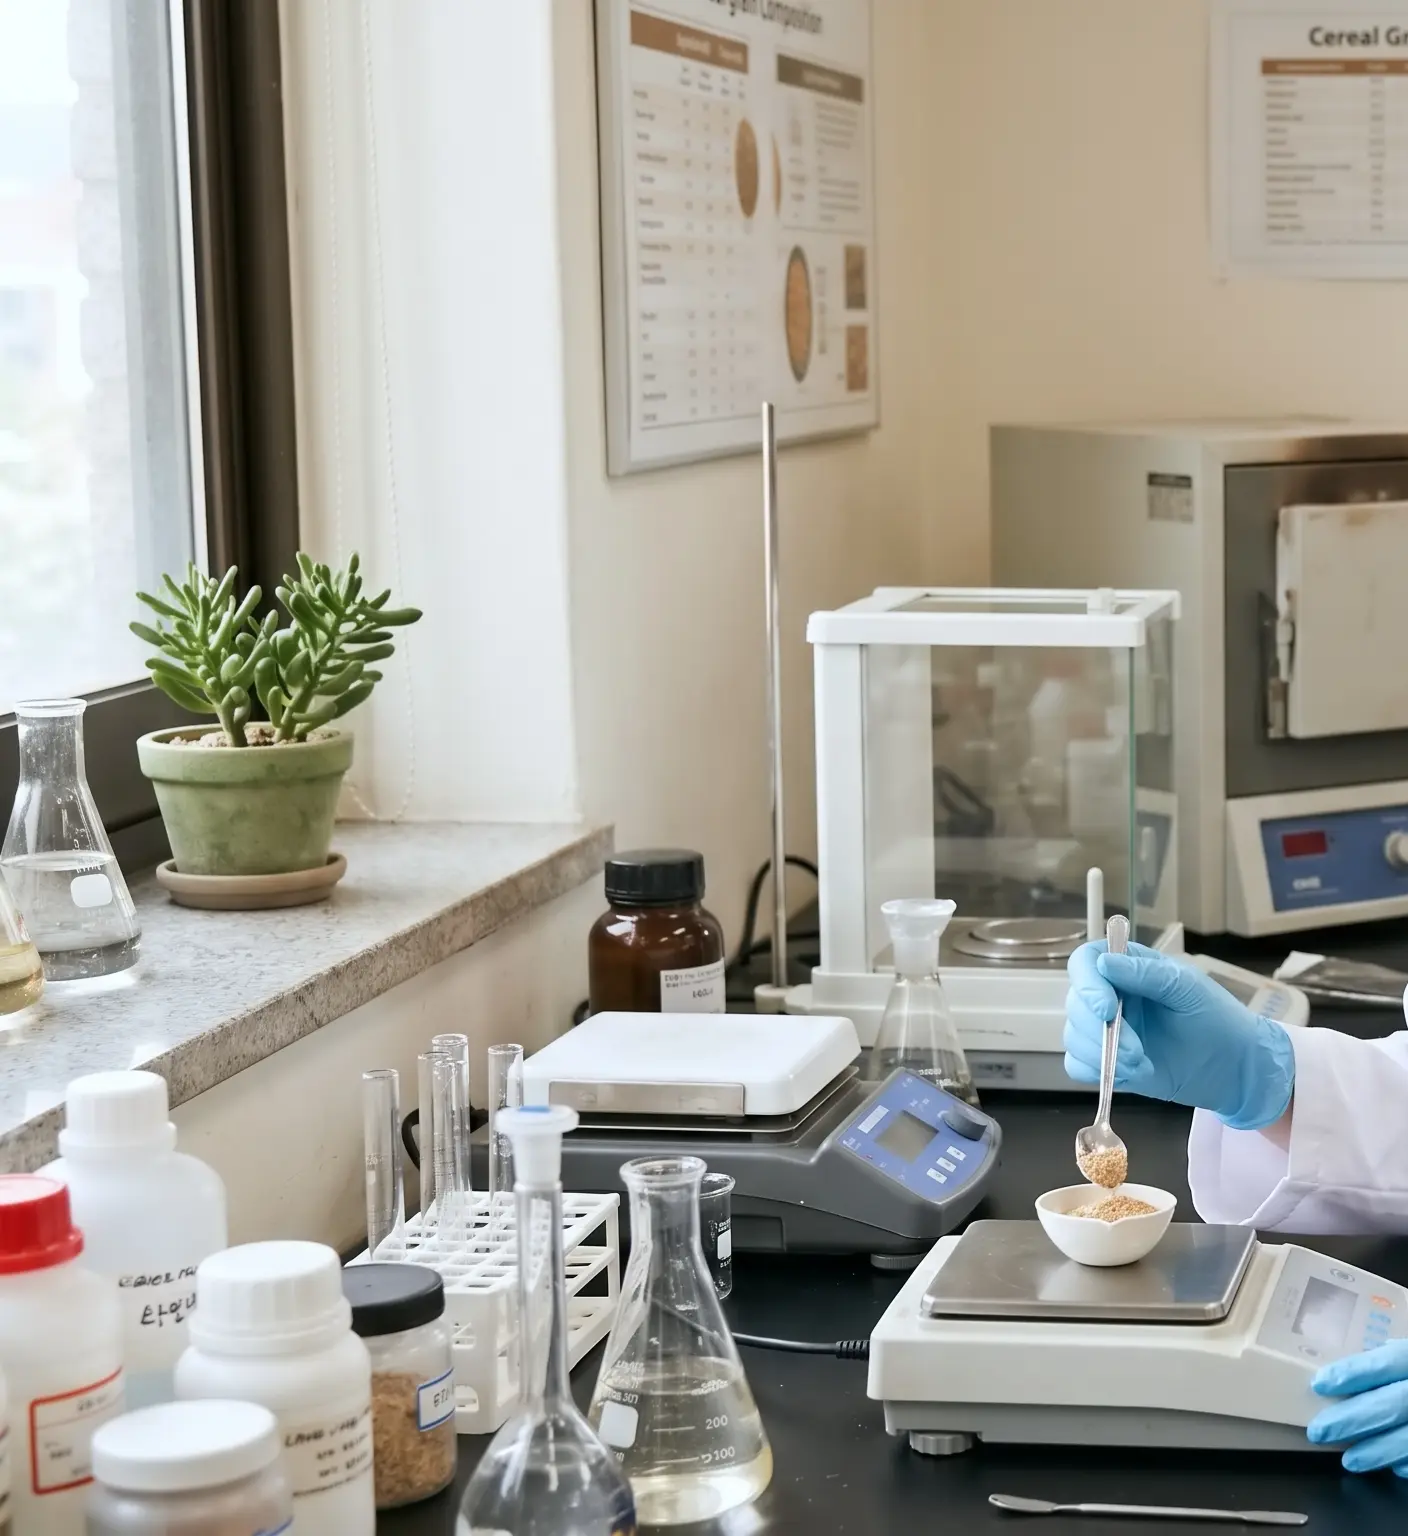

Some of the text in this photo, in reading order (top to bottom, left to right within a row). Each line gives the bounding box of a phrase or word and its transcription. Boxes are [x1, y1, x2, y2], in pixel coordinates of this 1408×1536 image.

[1308, 26, 1379, 47] Cereal
[705, 1414, 728, 1431] 200
[714, 1446, 736, 1461] 100
